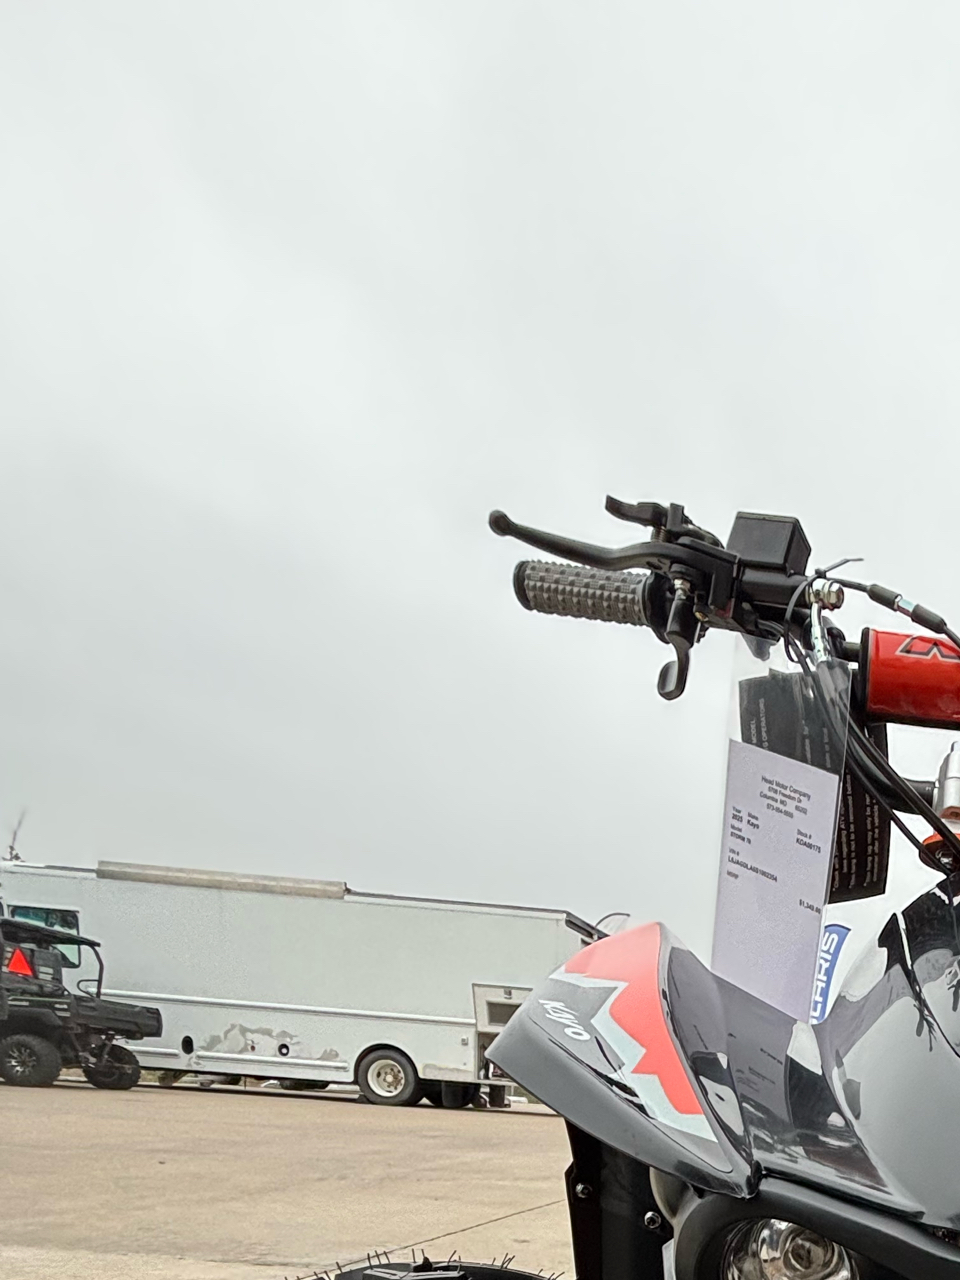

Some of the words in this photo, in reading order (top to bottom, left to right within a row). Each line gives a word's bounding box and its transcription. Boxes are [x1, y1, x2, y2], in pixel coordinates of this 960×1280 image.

[775, 780, 788, 791] Motor
[788, 785, 811, 801] Company
[747, 819, 760, 829] Kayo
[809, 932, 838, 1024] LARIS
